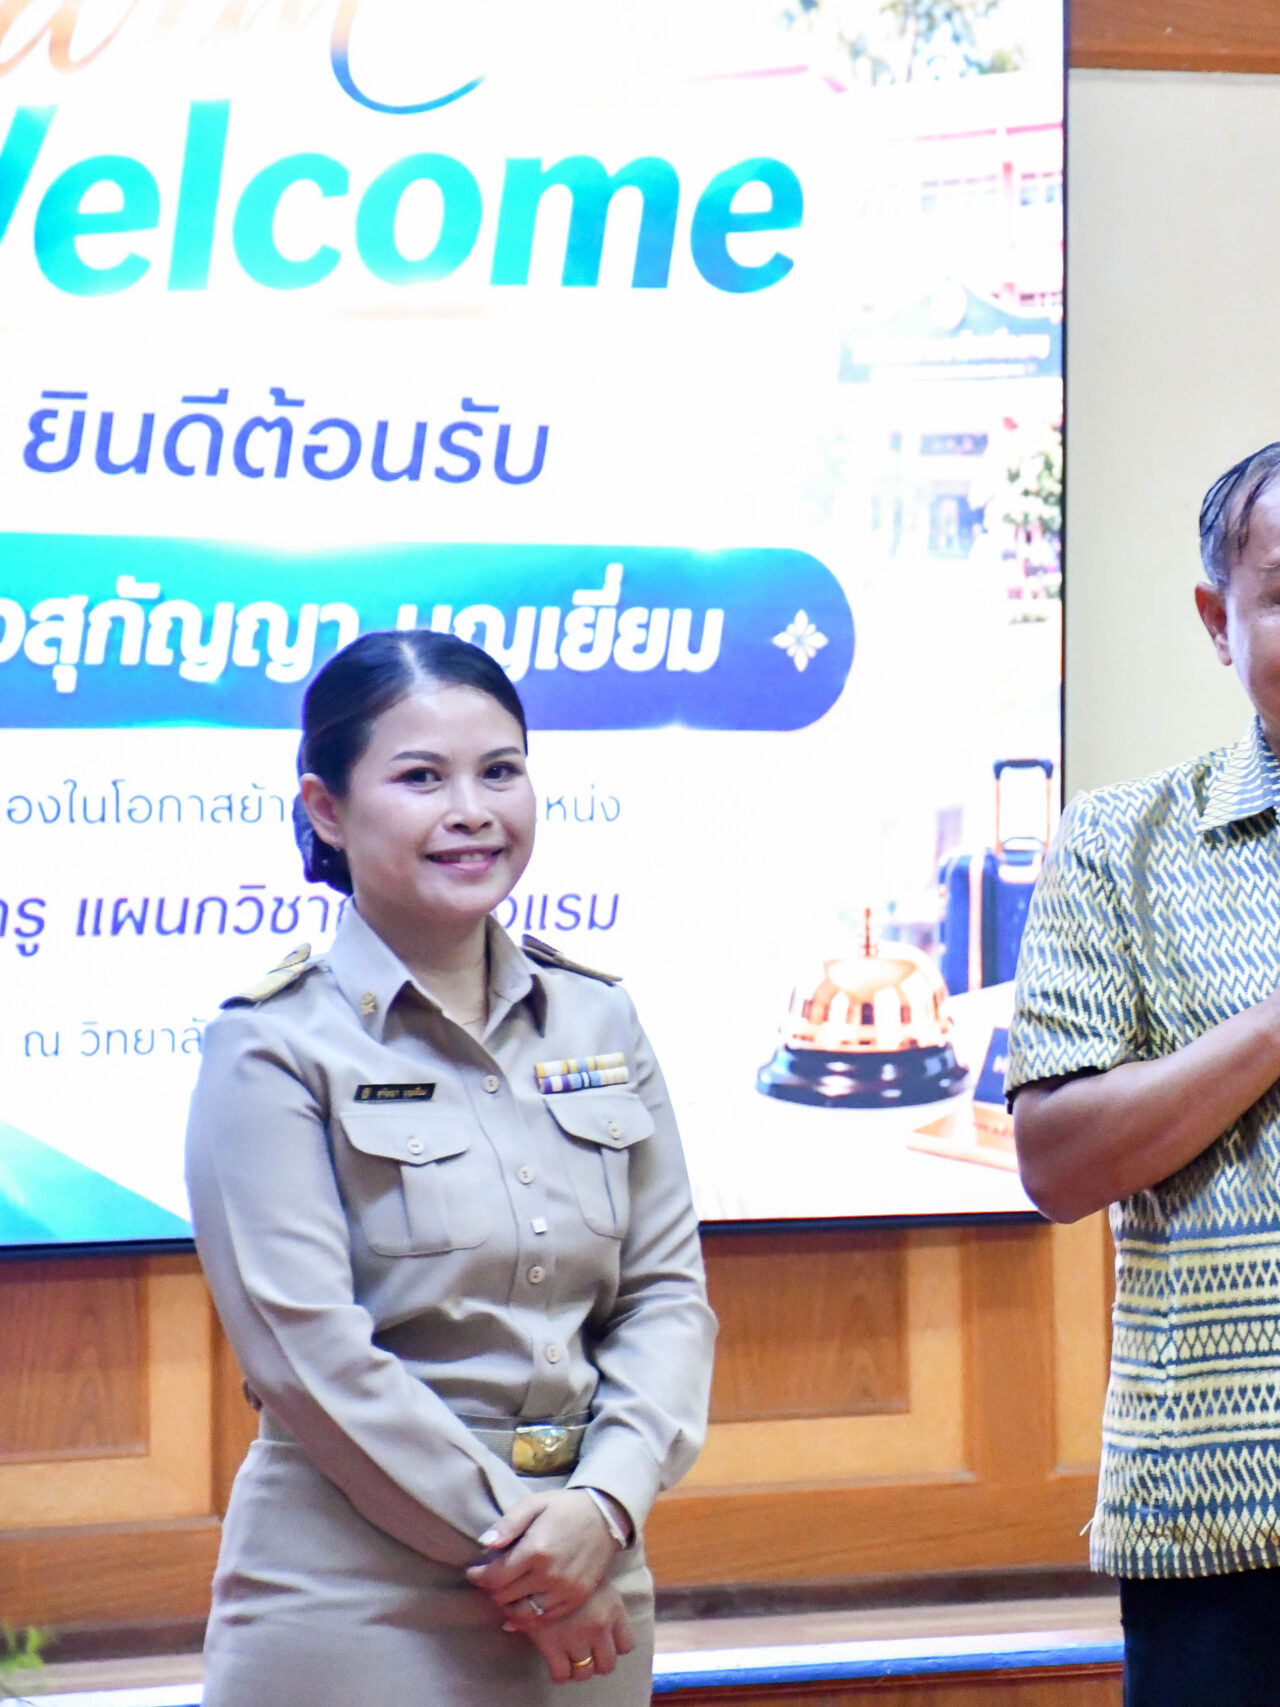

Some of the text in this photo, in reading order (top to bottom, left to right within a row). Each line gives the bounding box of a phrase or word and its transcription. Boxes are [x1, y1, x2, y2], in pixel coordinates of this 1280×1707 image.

[23, 388, 550, 486] ยินดีต้อนรับ
[0, 897, 46, 957] รู
[24, 1031, 59, 1057] ณ
